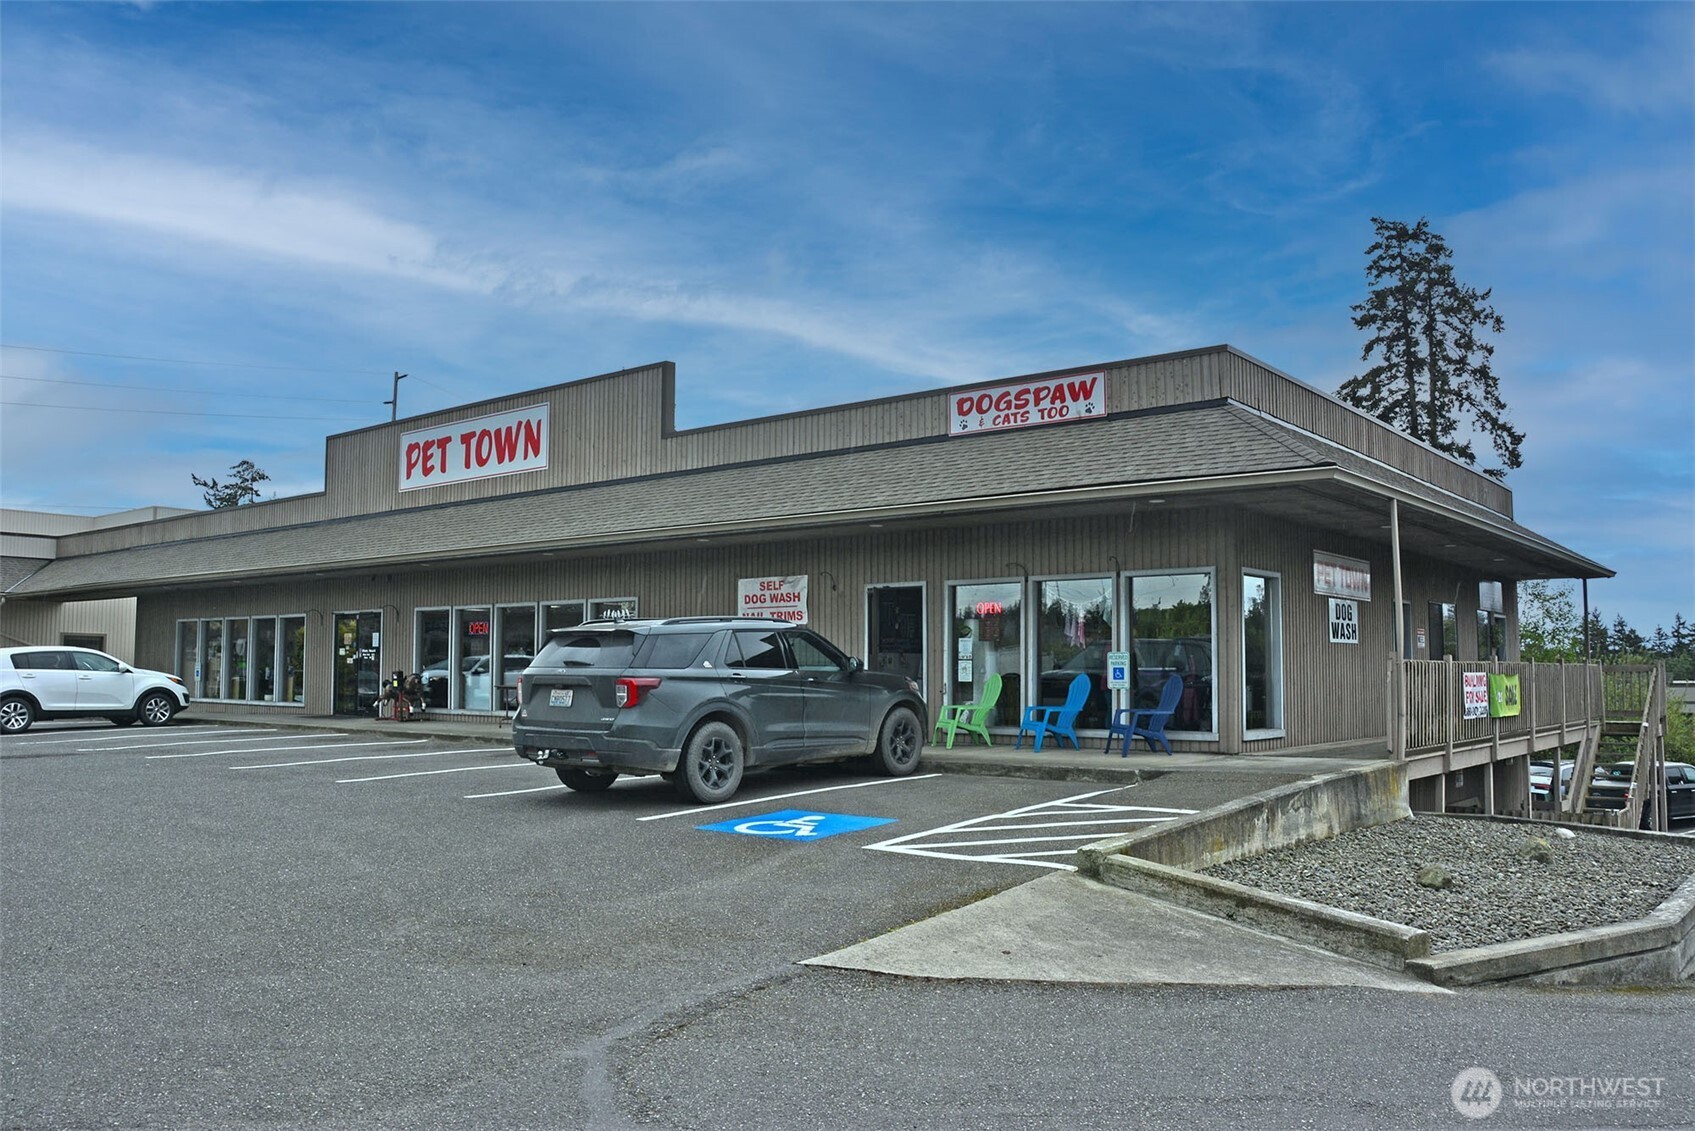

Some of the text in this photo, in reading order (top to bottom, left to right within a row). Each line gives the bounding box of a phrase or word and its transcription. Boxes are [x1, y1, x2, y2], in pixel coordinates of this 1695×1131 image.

[956, 376, 1098, 417] DOGSPAW
[992, 411, 1030, 427] CATS
[1038, 405, 1070, 420] TOO
[405, 418, 542, 480] PET TOWN
[759, 580, 785, 592] SELF
[1316, 560, 1369, 593] PET TOWN
[744, 591, 801, 605] DOG WASH
[976, 601, 1002, 615] OPEN
[1335, 603, 1353, 622] DOG
[469, 621, 489, 635] OPEN
[1331, 621, 1357, 641] WASH
